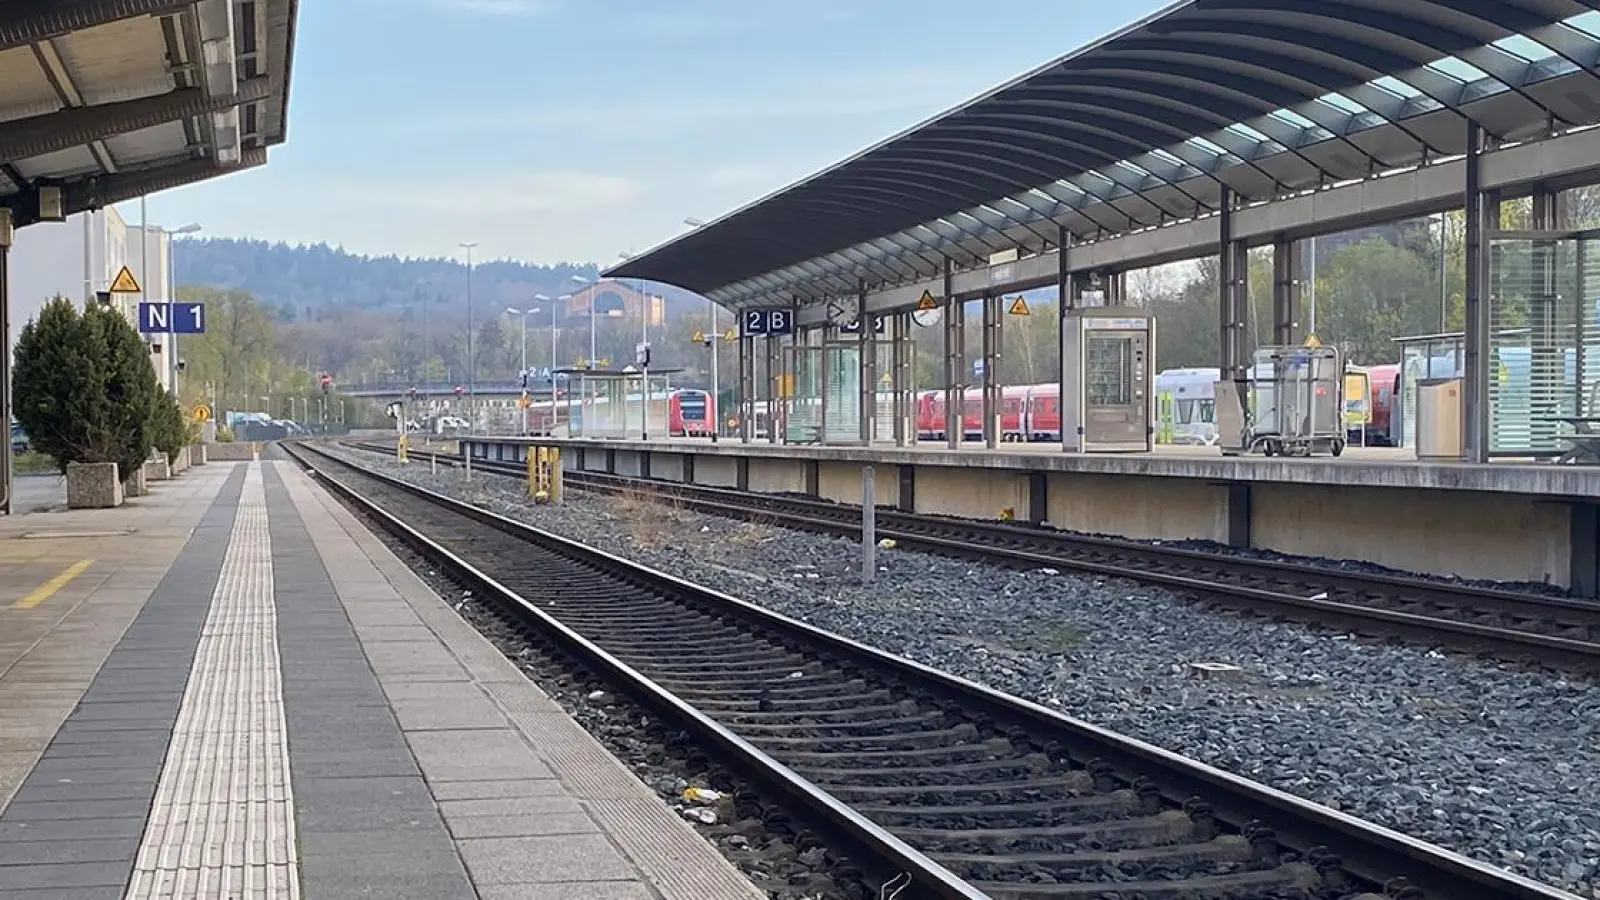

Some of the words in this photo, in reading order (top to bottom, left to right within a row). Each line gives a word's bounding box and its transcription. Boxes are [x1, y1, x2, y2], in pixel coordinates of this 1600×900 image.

[149, 304, 167, 328] N
[189, 304, 201, 329] 1
[749, 312, 761, 329] 2
[772, 312, 784, 329] B
[529, 366, 537, 377] 2
[542, 366, 551, 377] A
